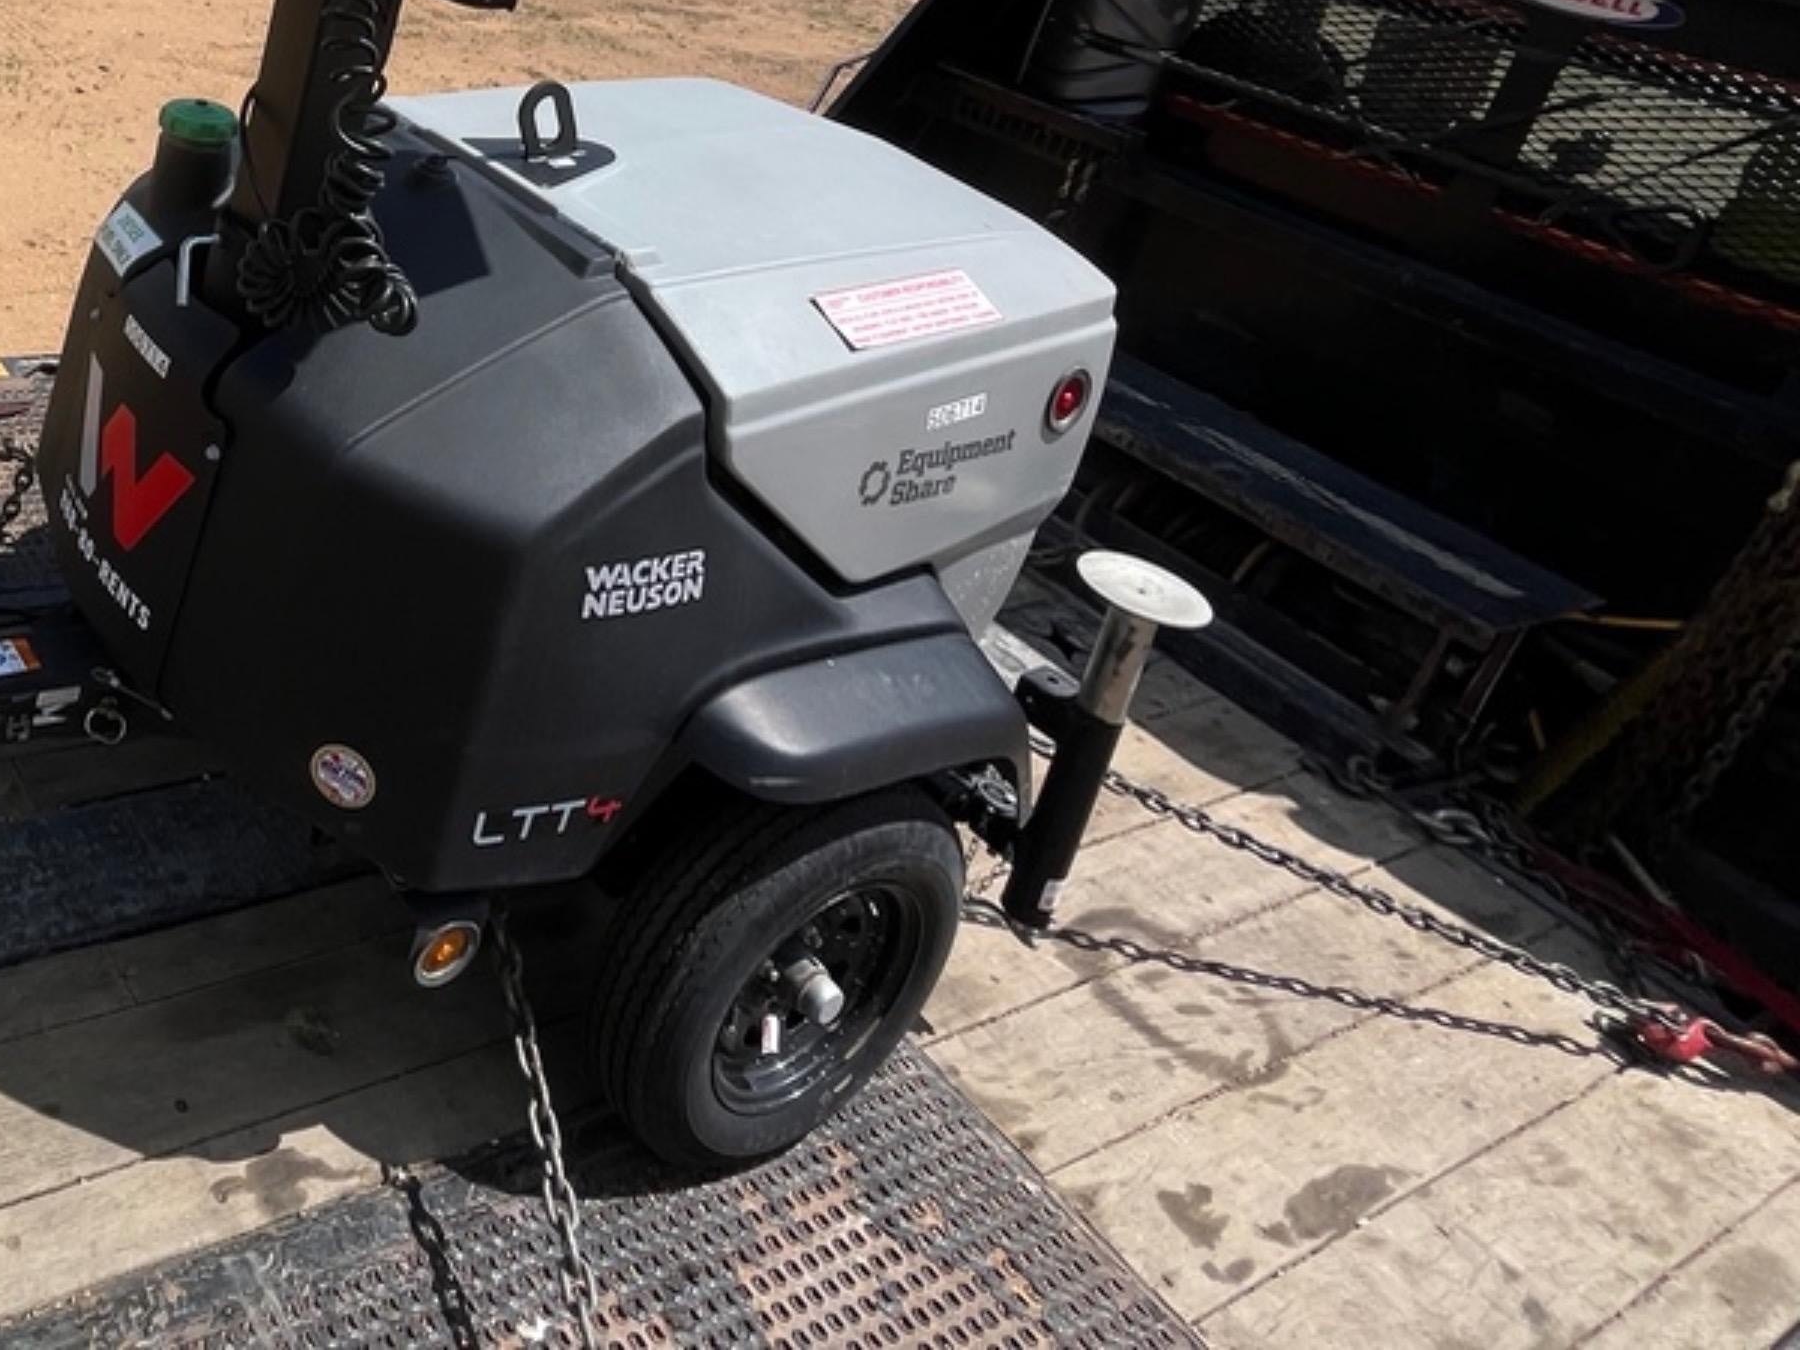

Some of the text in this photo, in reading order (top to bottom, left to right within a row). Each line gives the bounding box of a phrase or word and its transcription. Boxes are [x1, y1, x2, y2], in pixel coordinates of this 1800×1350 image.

[896, 428, 1016, 477] Equipment
[888, 474, 957, 506] Share
[584, 548, 706, 592] WACKER
[581, 575, 703, 619] NEUSON
[472, 796, 622, 847] LTT4
